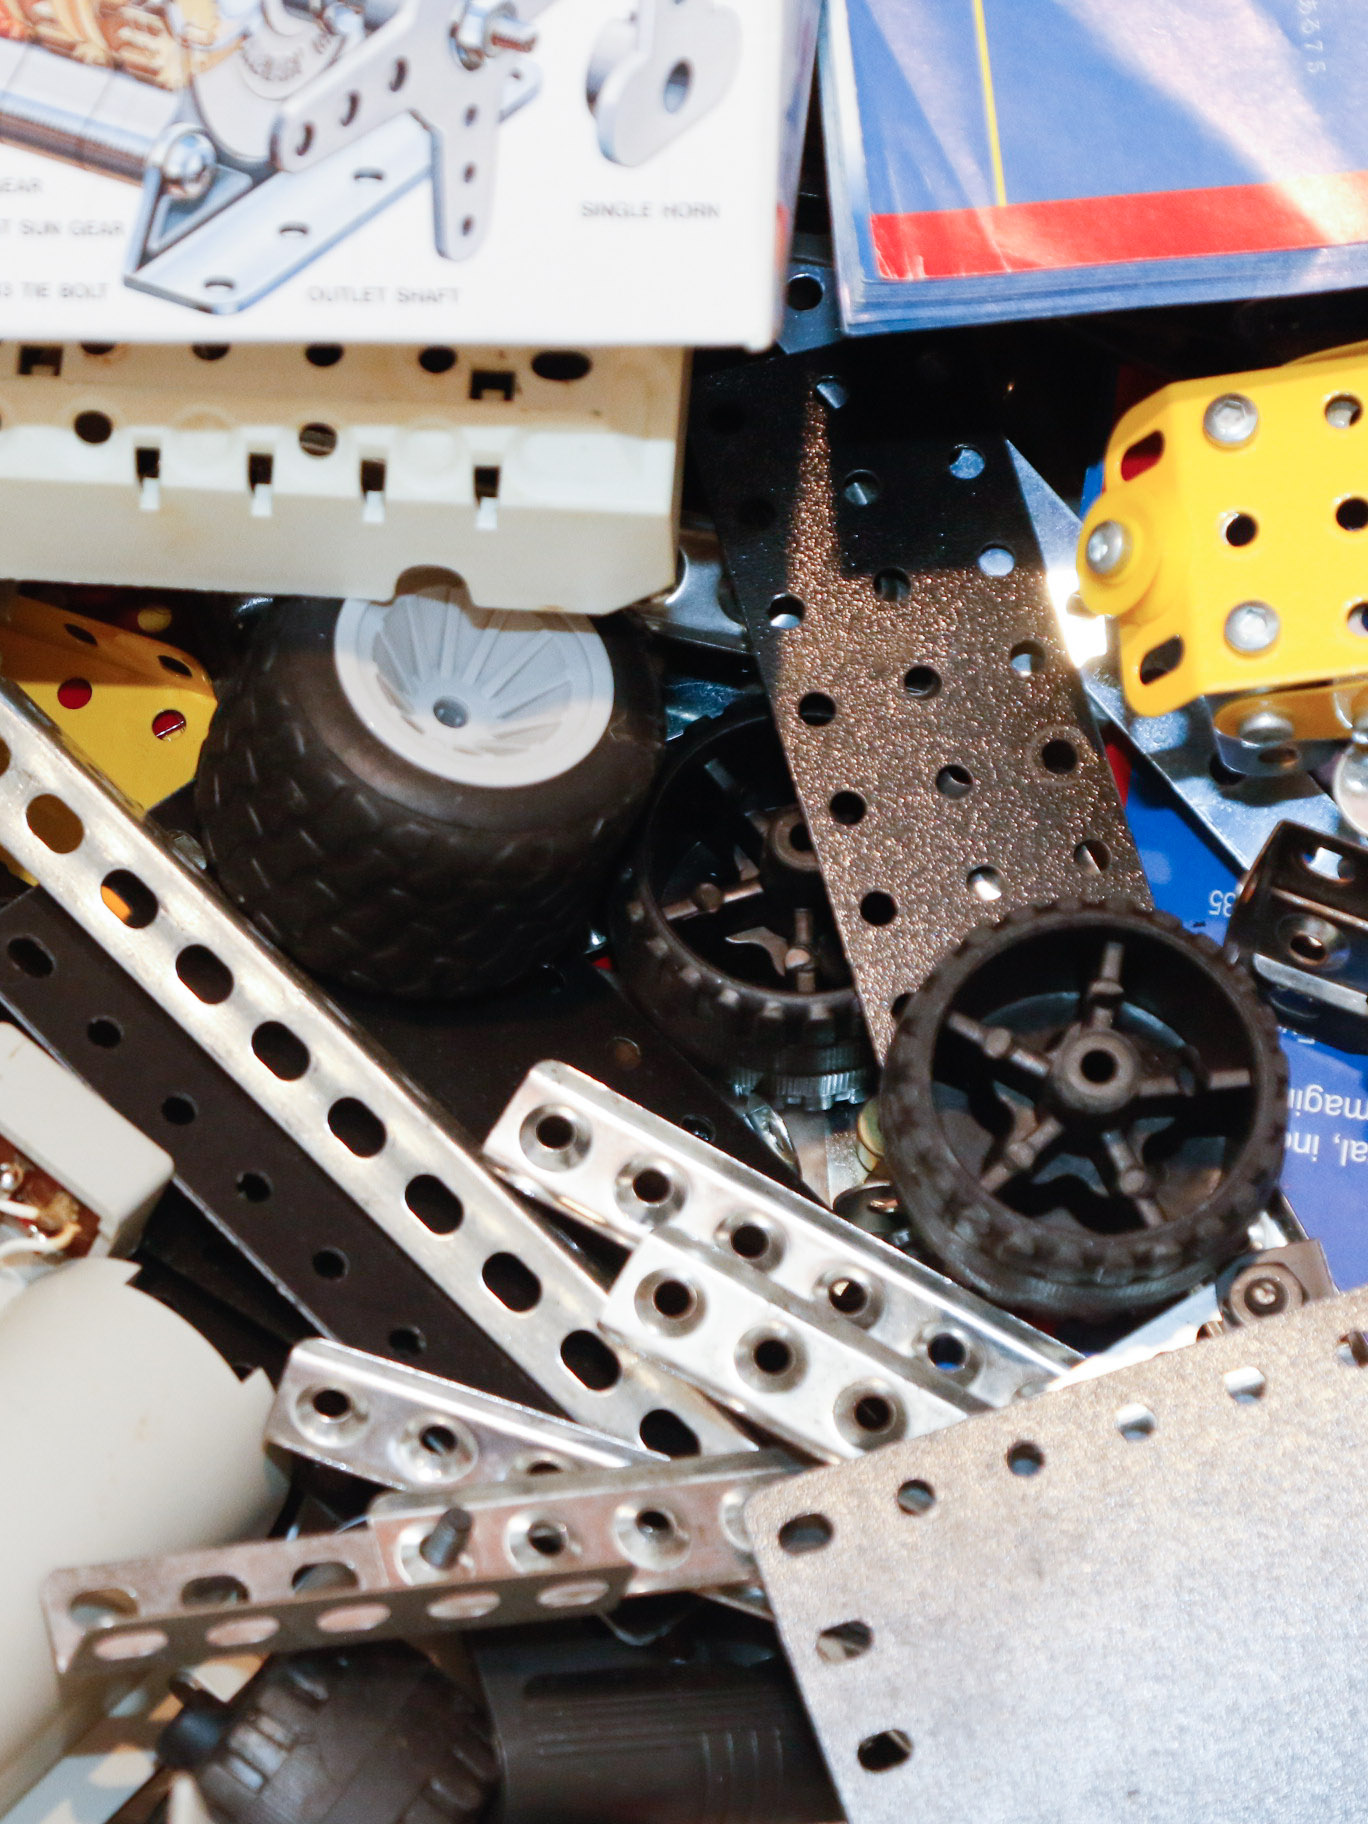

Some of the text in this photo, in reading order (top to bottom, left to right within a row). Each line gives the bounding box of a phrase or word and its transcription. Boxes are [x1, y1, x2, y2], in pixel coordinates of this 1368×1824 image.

[581, 202, 720, 219] SINGLE HORN
[21, 219, 61, 236] SUN
[69, 220, 125, 237] GEAR
[61, 282, 109, 300] BOLT
[308, 286, 461, 305] OUTLET SHAFT
